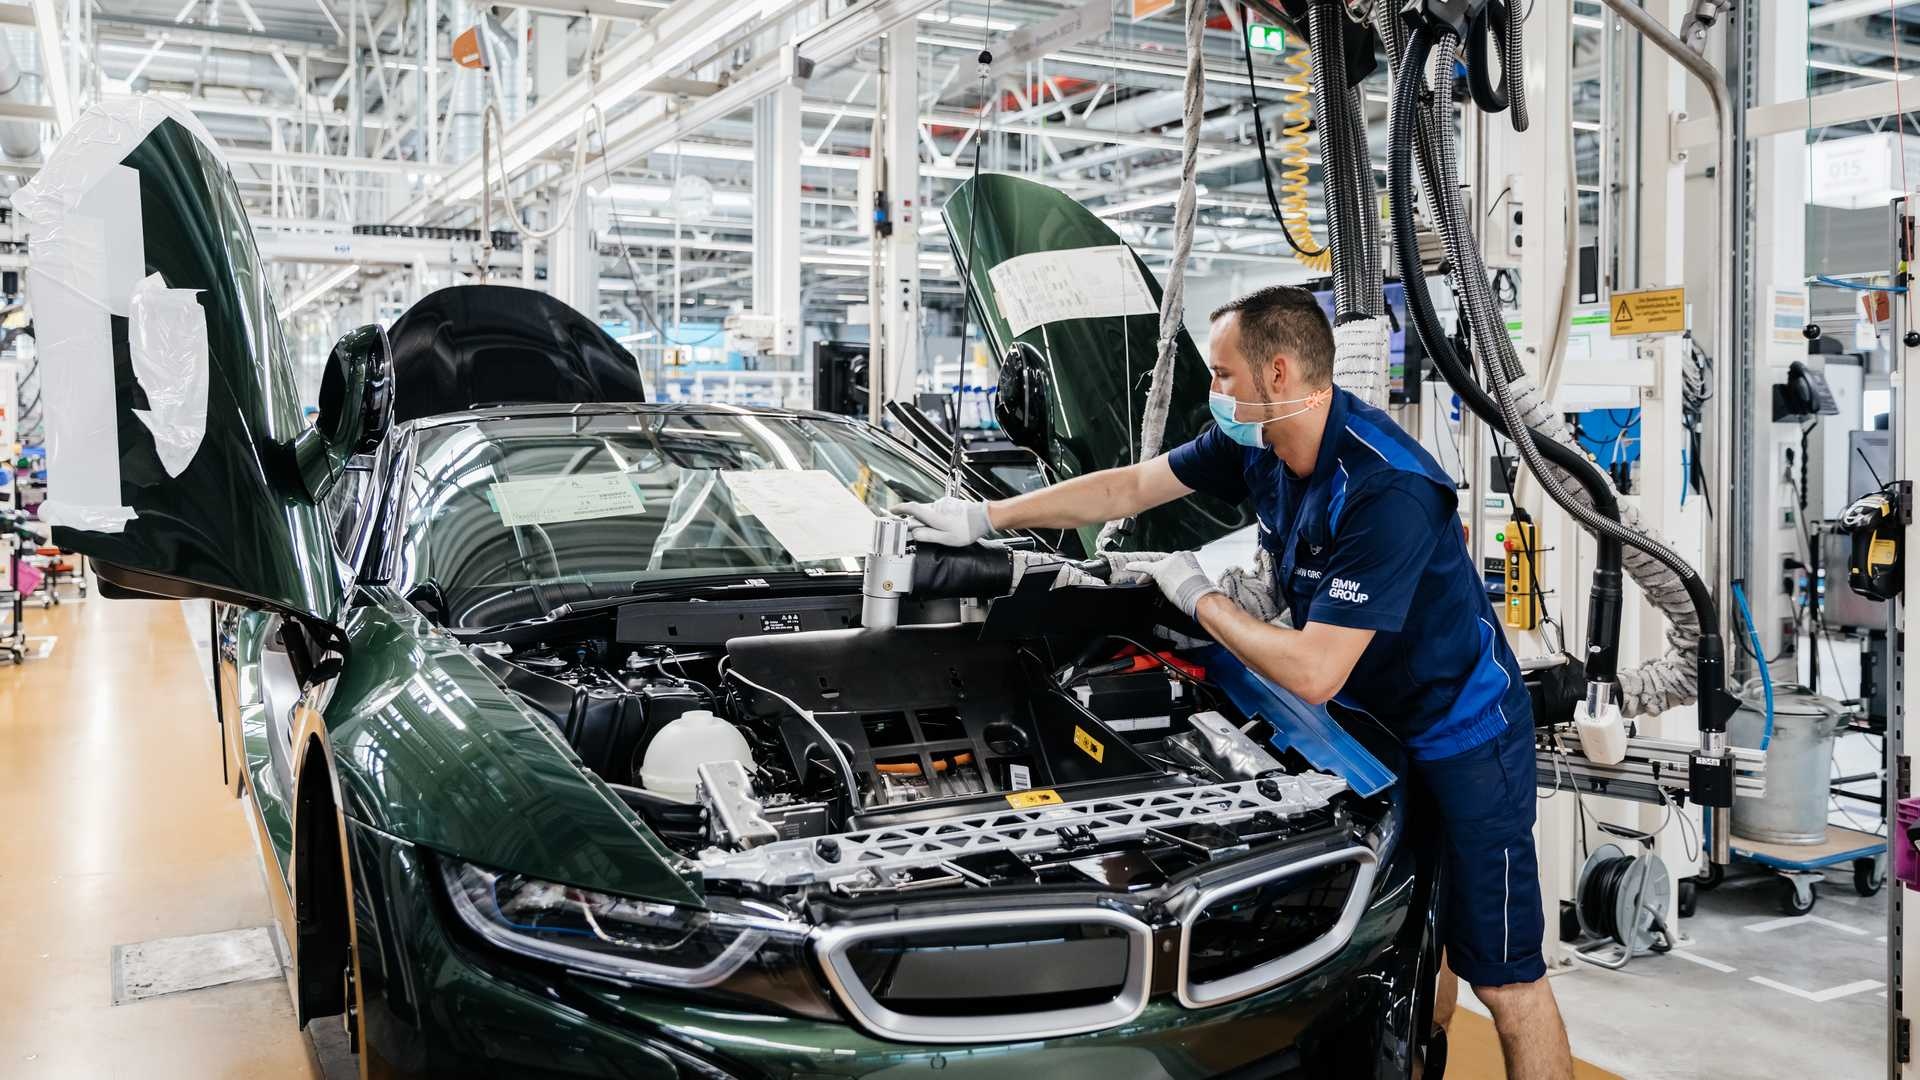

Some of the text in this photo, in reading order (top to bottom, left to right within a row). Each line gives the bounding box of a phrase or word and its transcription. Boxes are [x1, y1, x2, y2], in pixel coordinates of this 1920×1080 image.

[1294, 567, 1307, 577] MW
[1331, 577, 1361, 592] BMW
[1329, 588, 1369, 603] GROUP
